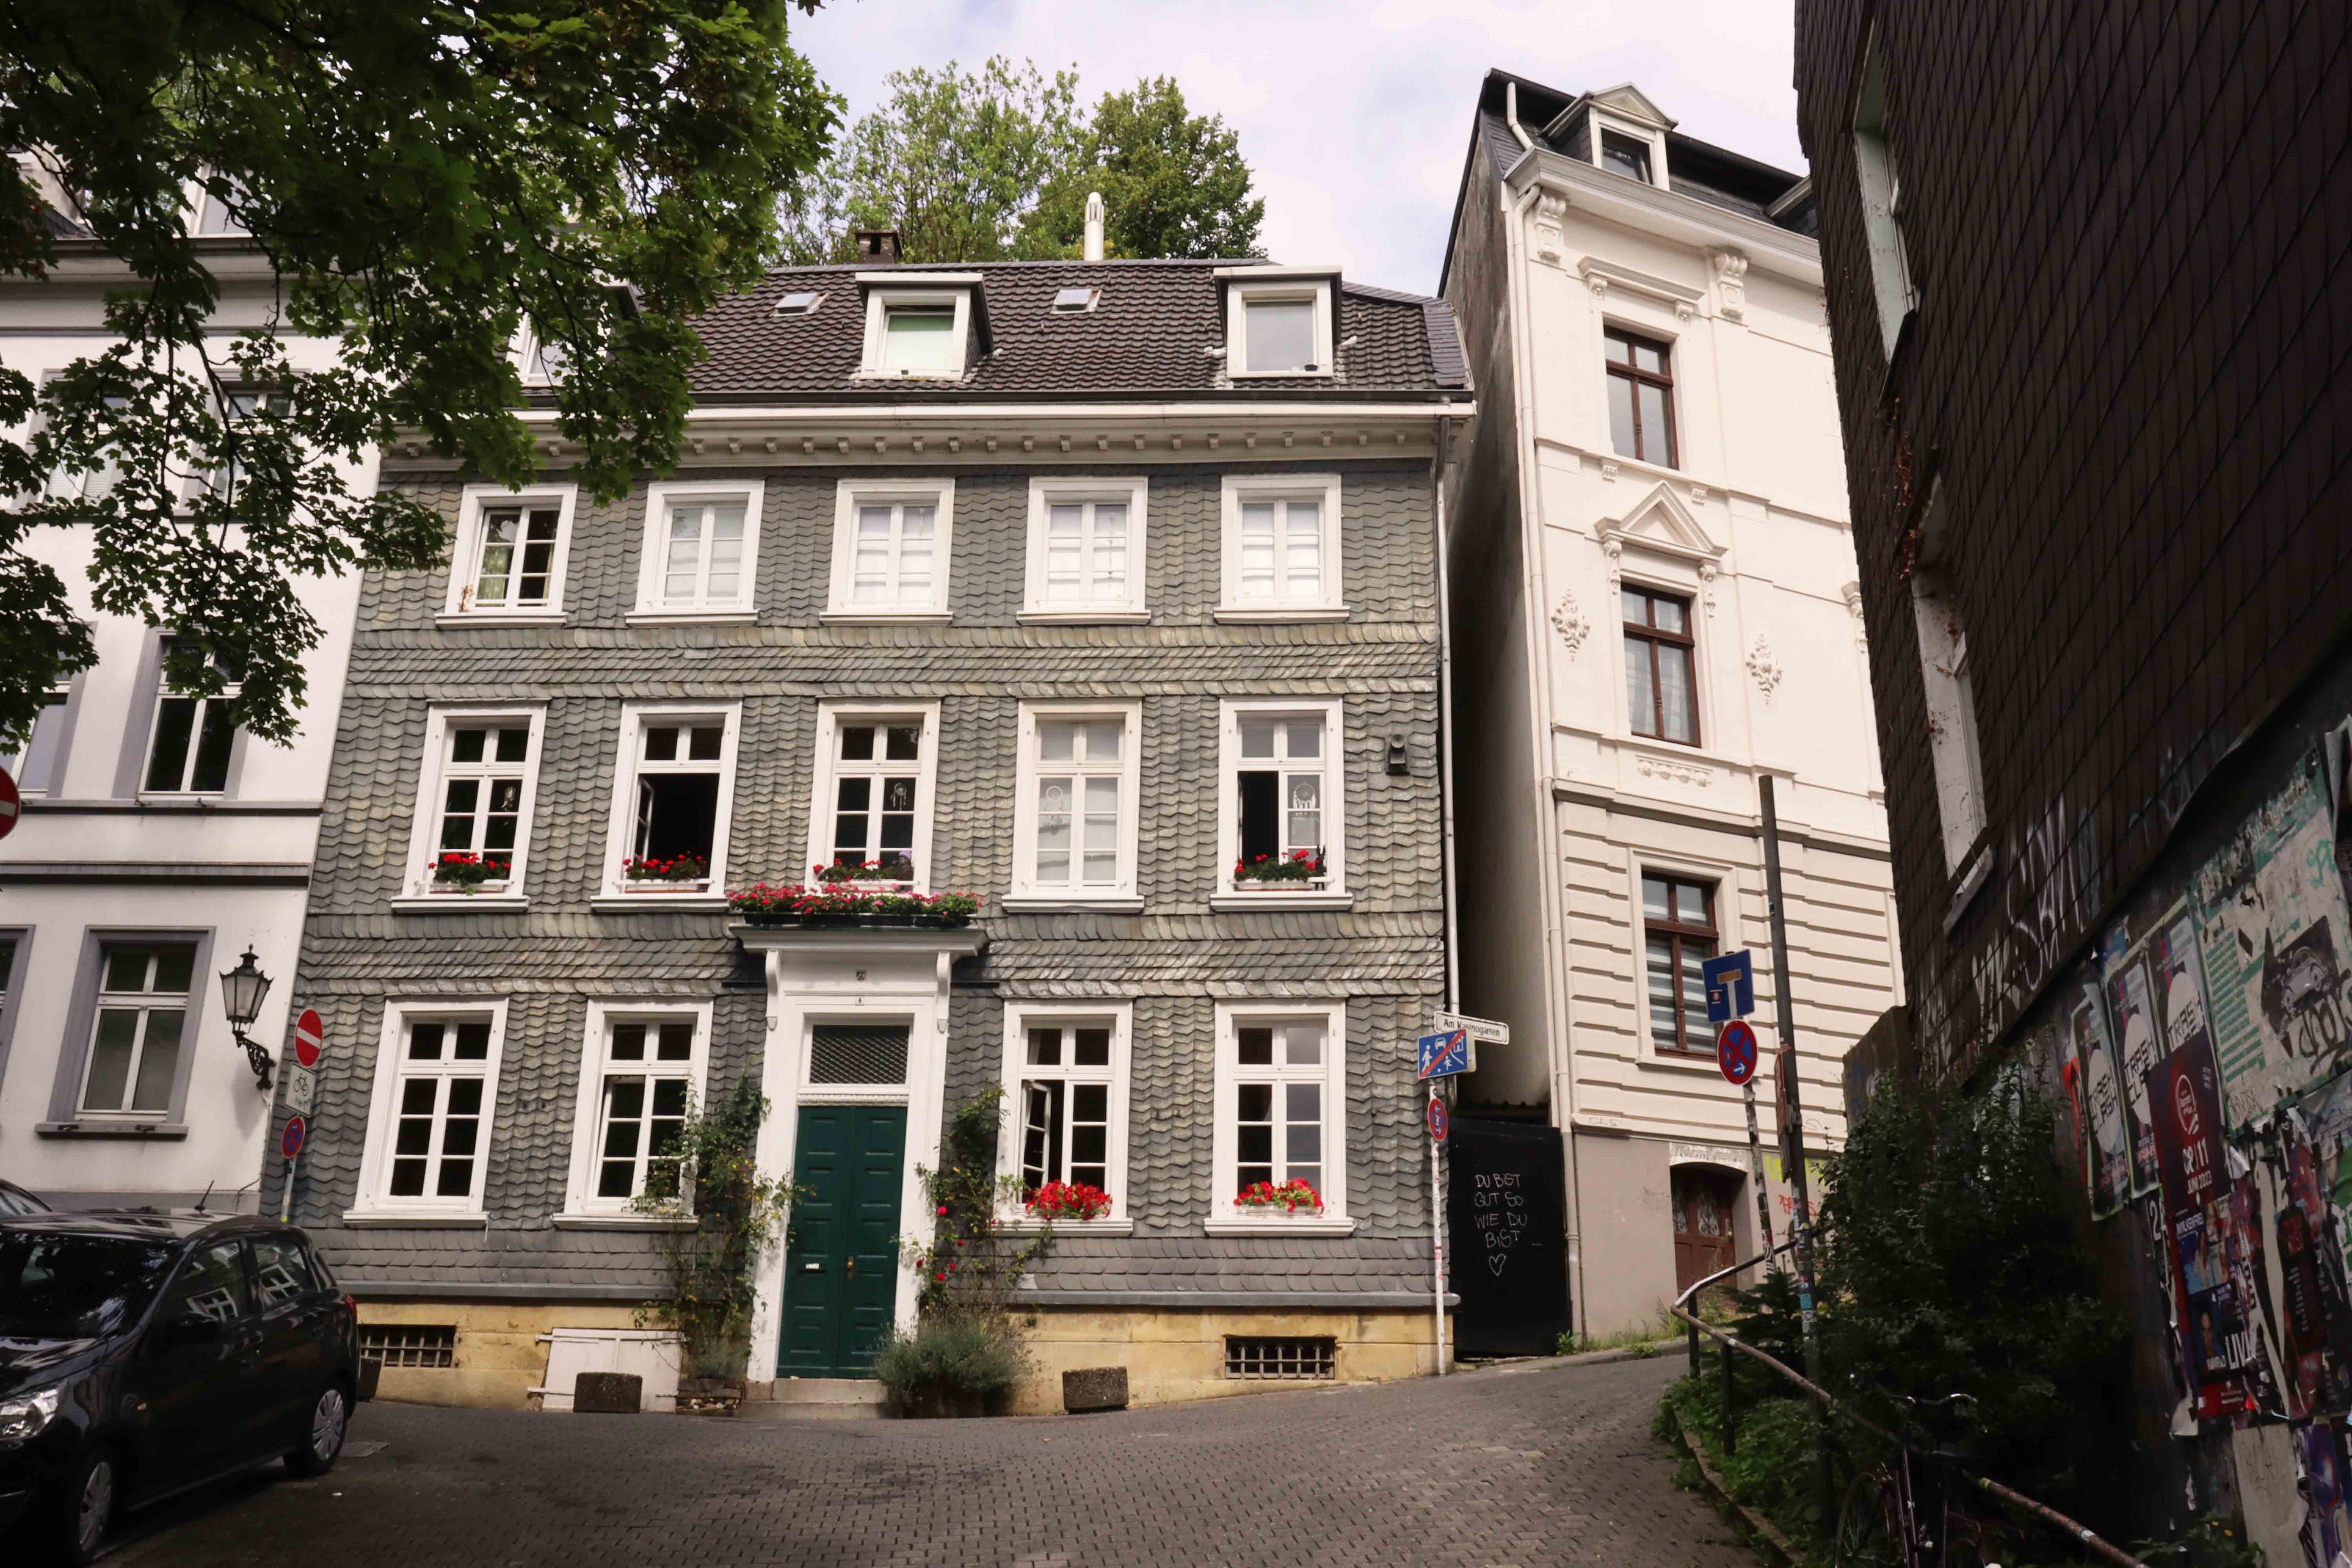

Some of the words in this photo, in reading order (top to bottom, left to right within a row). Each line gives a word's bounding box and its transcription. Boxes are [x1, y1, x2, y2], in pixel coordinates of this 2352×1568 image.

[1444, 1019, 1455, 1028] Am
[1457, 1021, 1500, 1037] Kasinogarten
[1475, 1174, 1490, 1188] DU
[1474, 1192, 1499, 1207] GUT
[1474, 1214, 1499, 1229] WIE
[1506, 1212, 1528, 1227] DU
